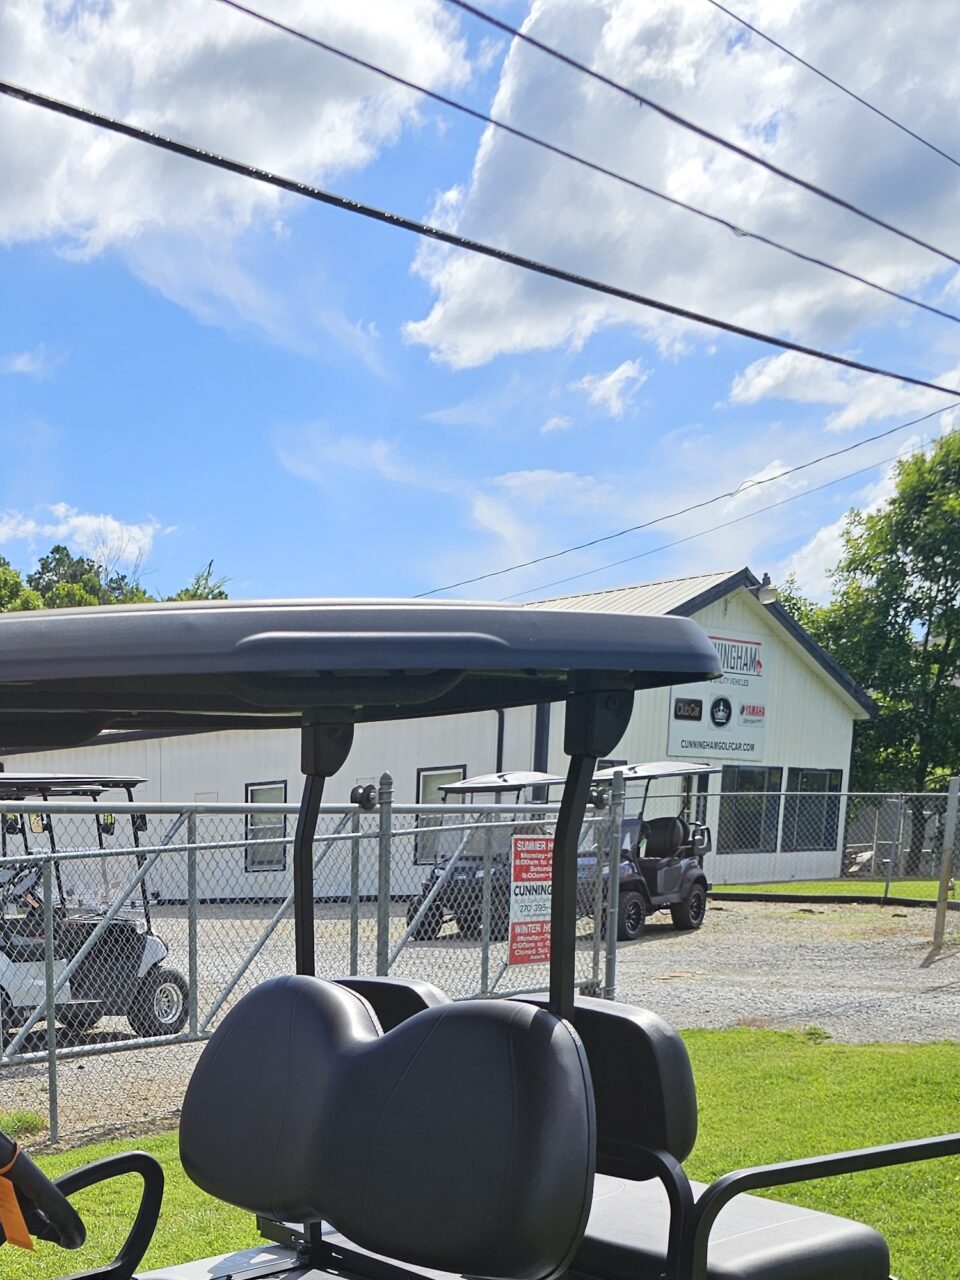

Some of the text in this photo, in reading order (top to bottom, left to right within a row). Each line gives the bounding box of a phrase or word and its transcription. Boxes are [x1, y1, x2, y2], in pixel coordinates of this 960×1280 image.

[745, 704, 765, 717] YAMAHA
[681, 739, 755, 752] CUNNINGHAMGOLFCAR.COM
[516, 840, 546, 851] SUMMER
[514, 884, 552, 896] CUNNING
[515, 924, 541, 934] WINTER
